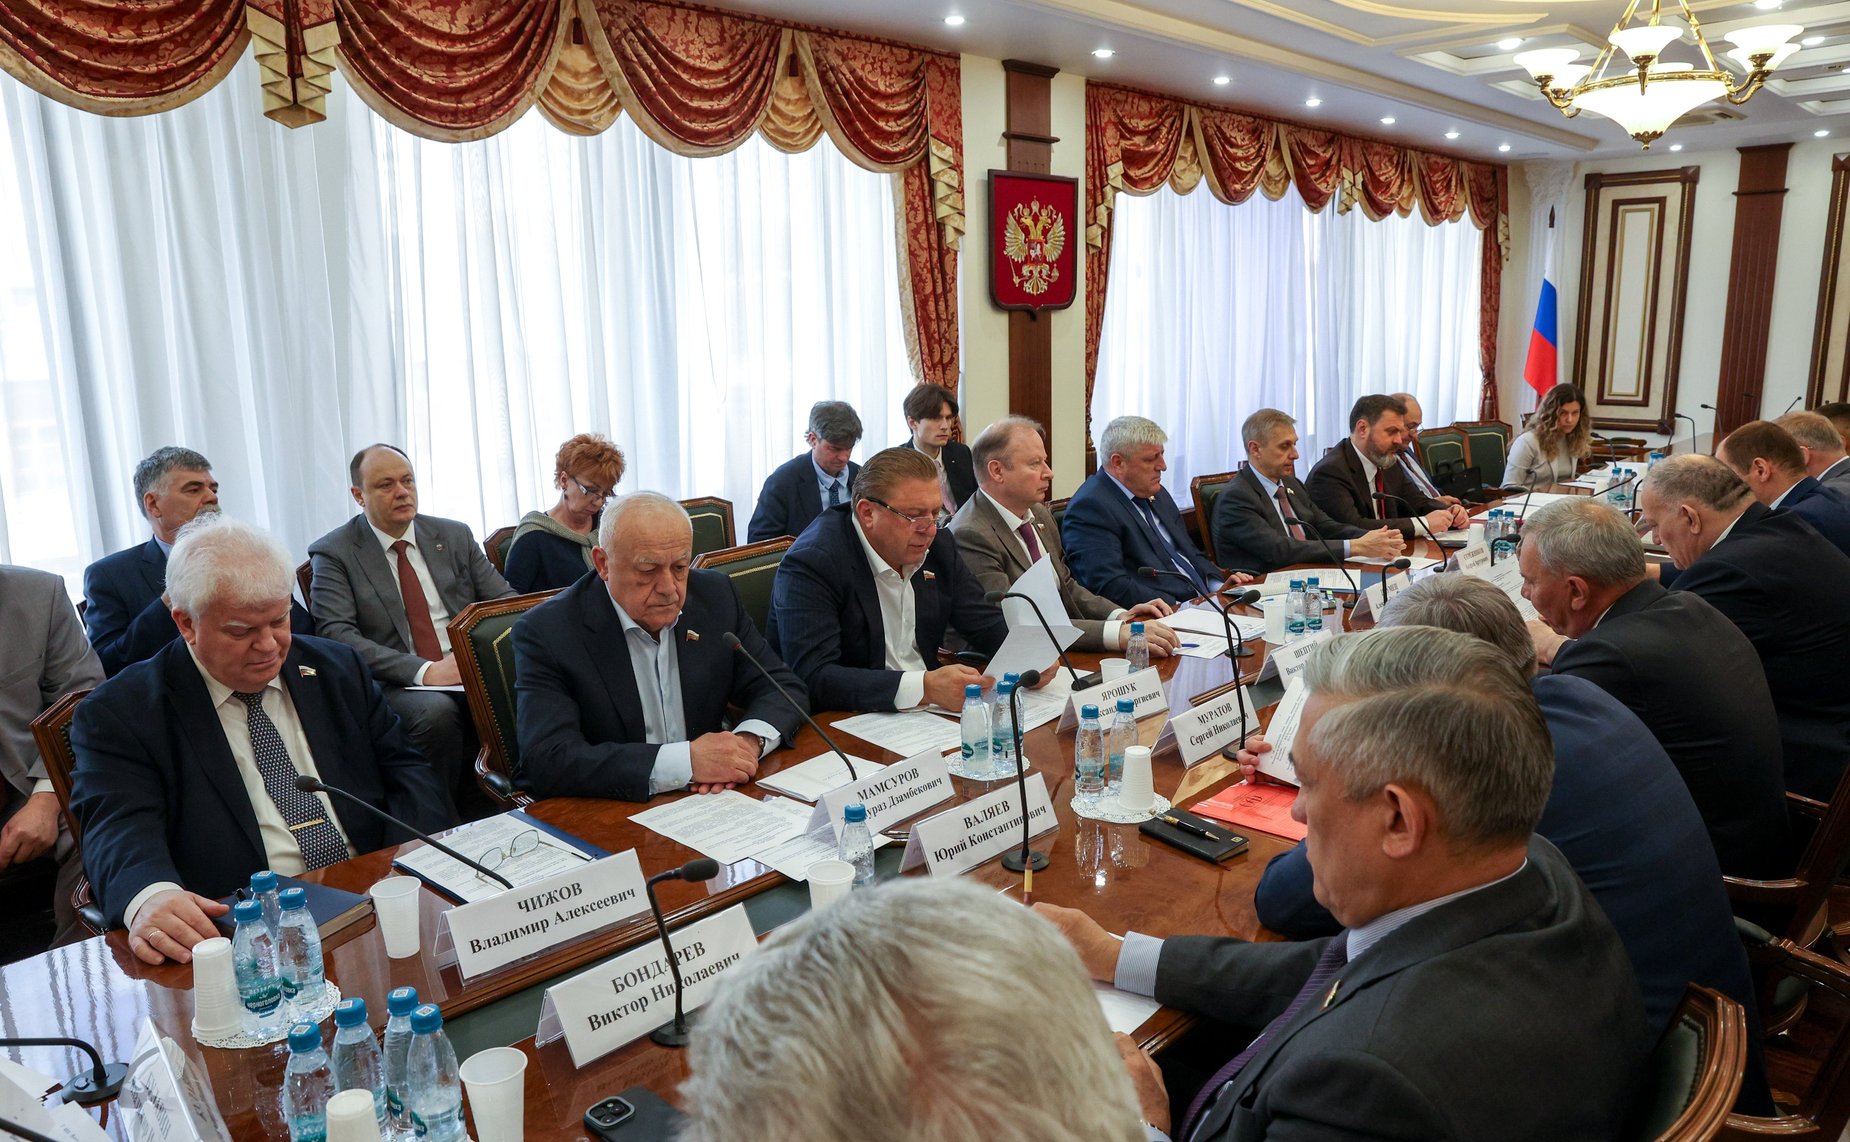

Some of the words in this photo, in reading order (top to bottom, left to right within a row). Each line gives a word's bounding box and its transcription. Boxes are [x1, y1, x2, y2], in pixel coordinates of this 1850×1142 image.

[1101, 682, 1137, 702] ЯРОШУК
[1189, 728, 1214, 746] Сергей
[1212, 712, 1249, 735] Николаевч
[1197, 702, 1233, 725] МУРАТОВ
[857, 767, 920, 802] МАМСУРОВ
[888, 777, 943, 809] Дзамбекович
[963, 800, 1010, 830] ВАЛЯЕВ
[933, 838, 968, 863] Юрий
[517, 882, 583, 913] ЧИЖОВ
[468, 918, 550, 954] Владимир
[553, 888, 637, 925] Алексеевич
[587, 995, 649, 1032] Виктор
